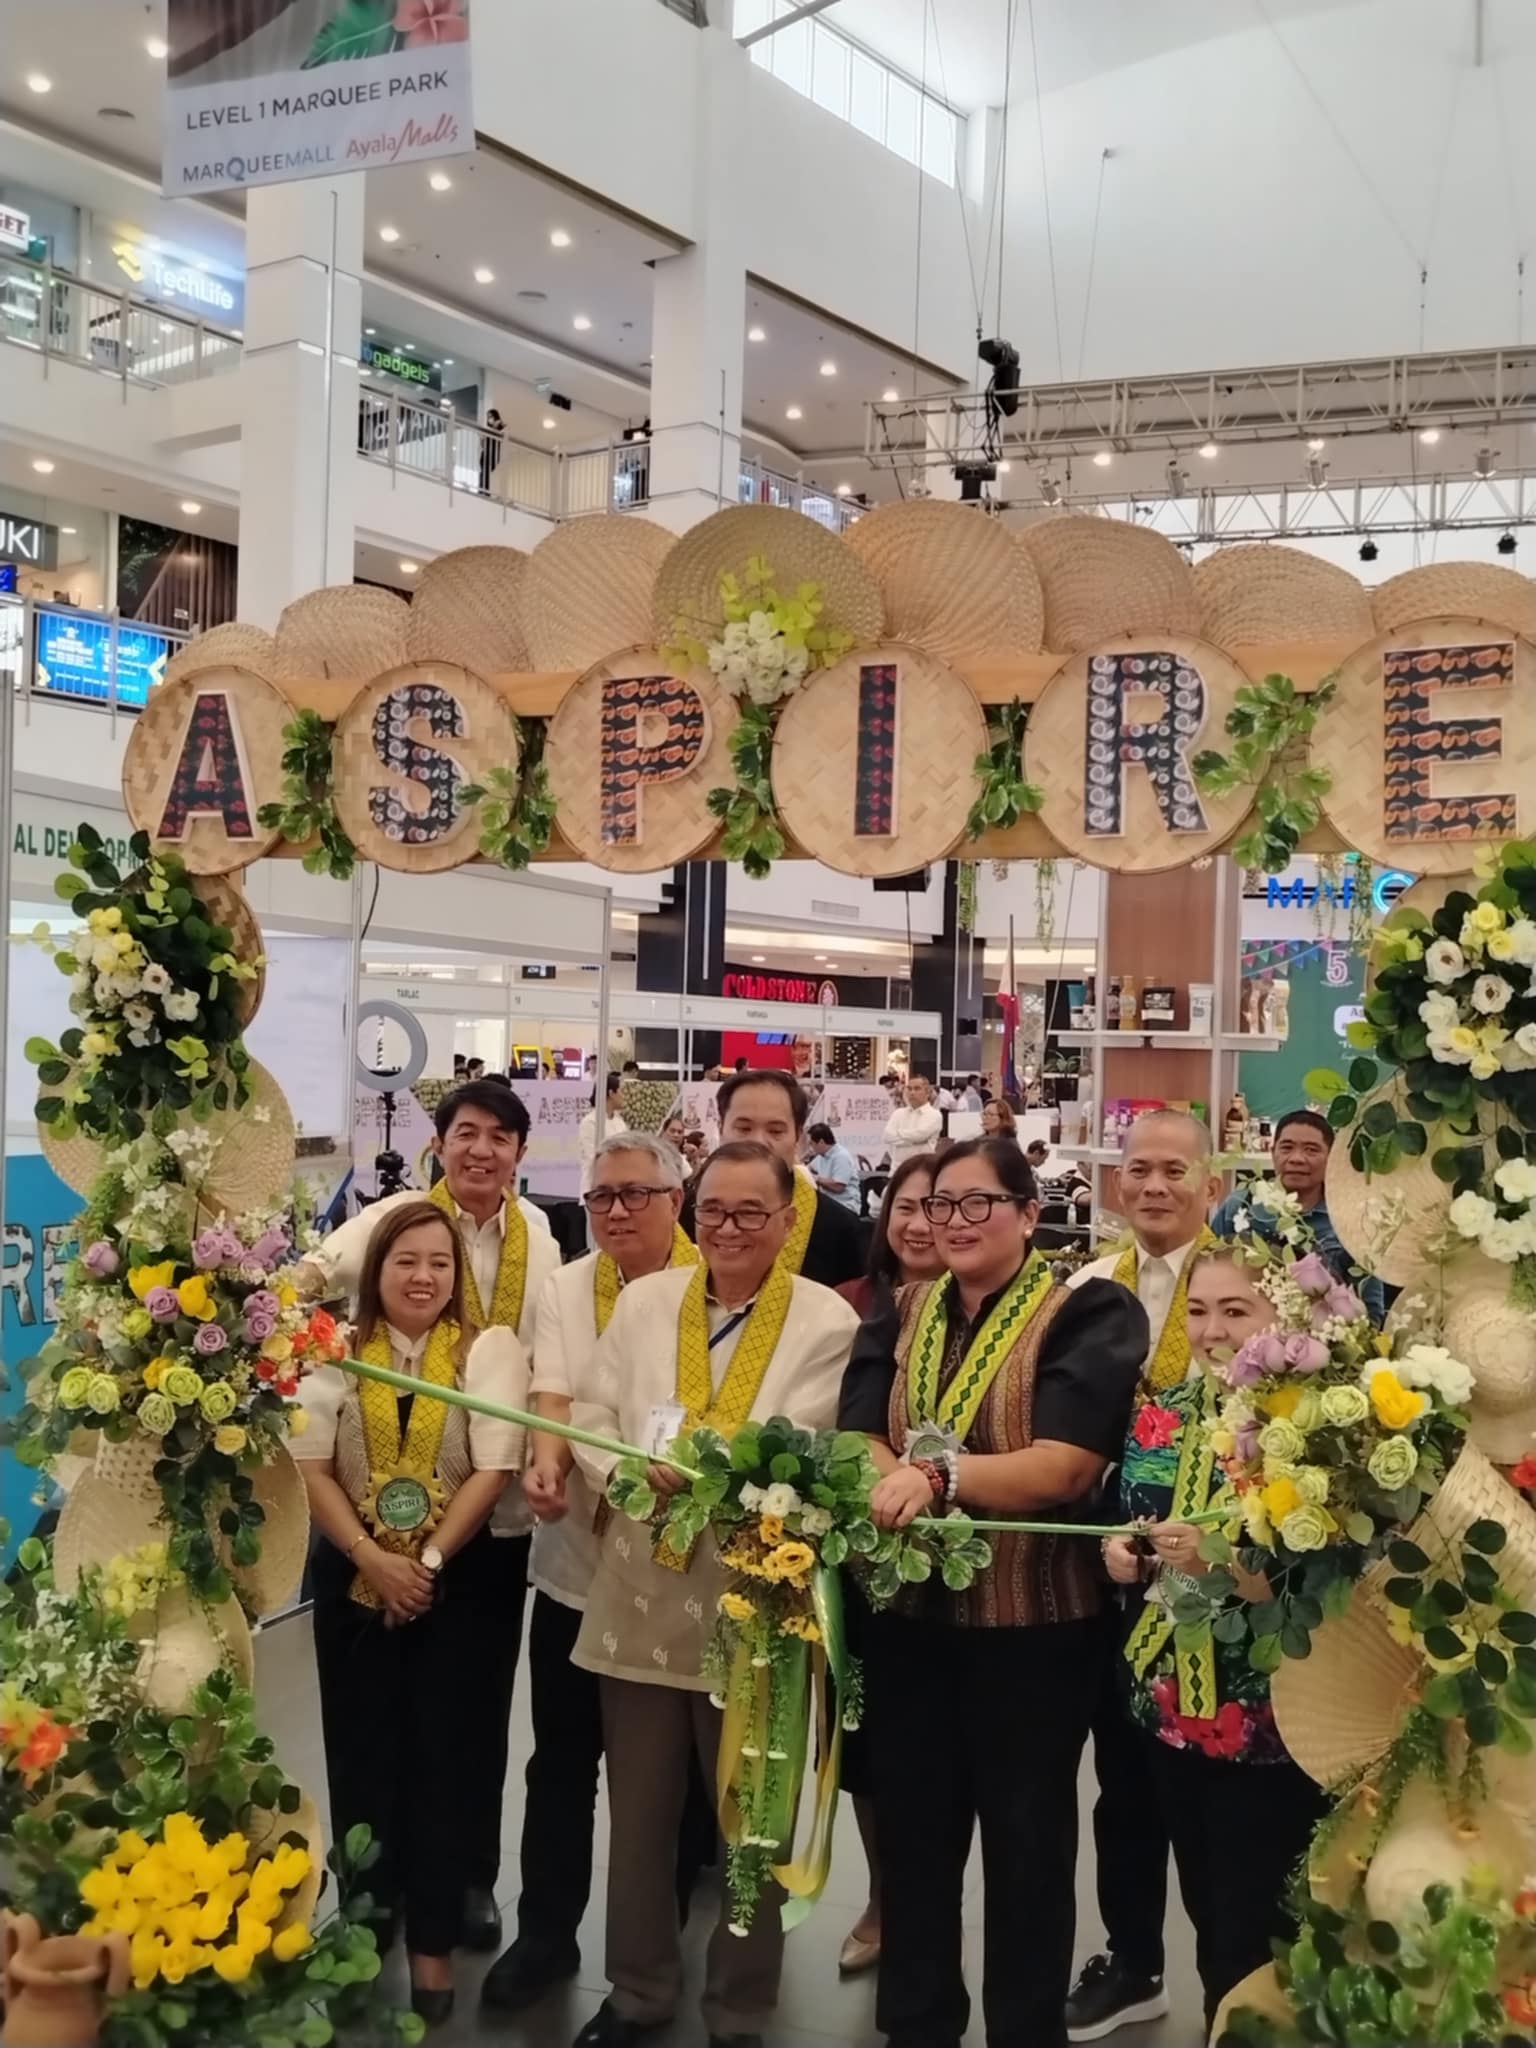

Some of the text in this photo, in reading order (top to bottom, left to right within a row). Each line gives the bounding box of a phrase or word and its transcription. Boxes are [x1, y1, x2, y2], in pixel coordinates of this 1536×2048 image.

[186, 70, 449, 131] LEVEL 1 MARQUEE PARK
[151, 260, 236, 310] TechLife
